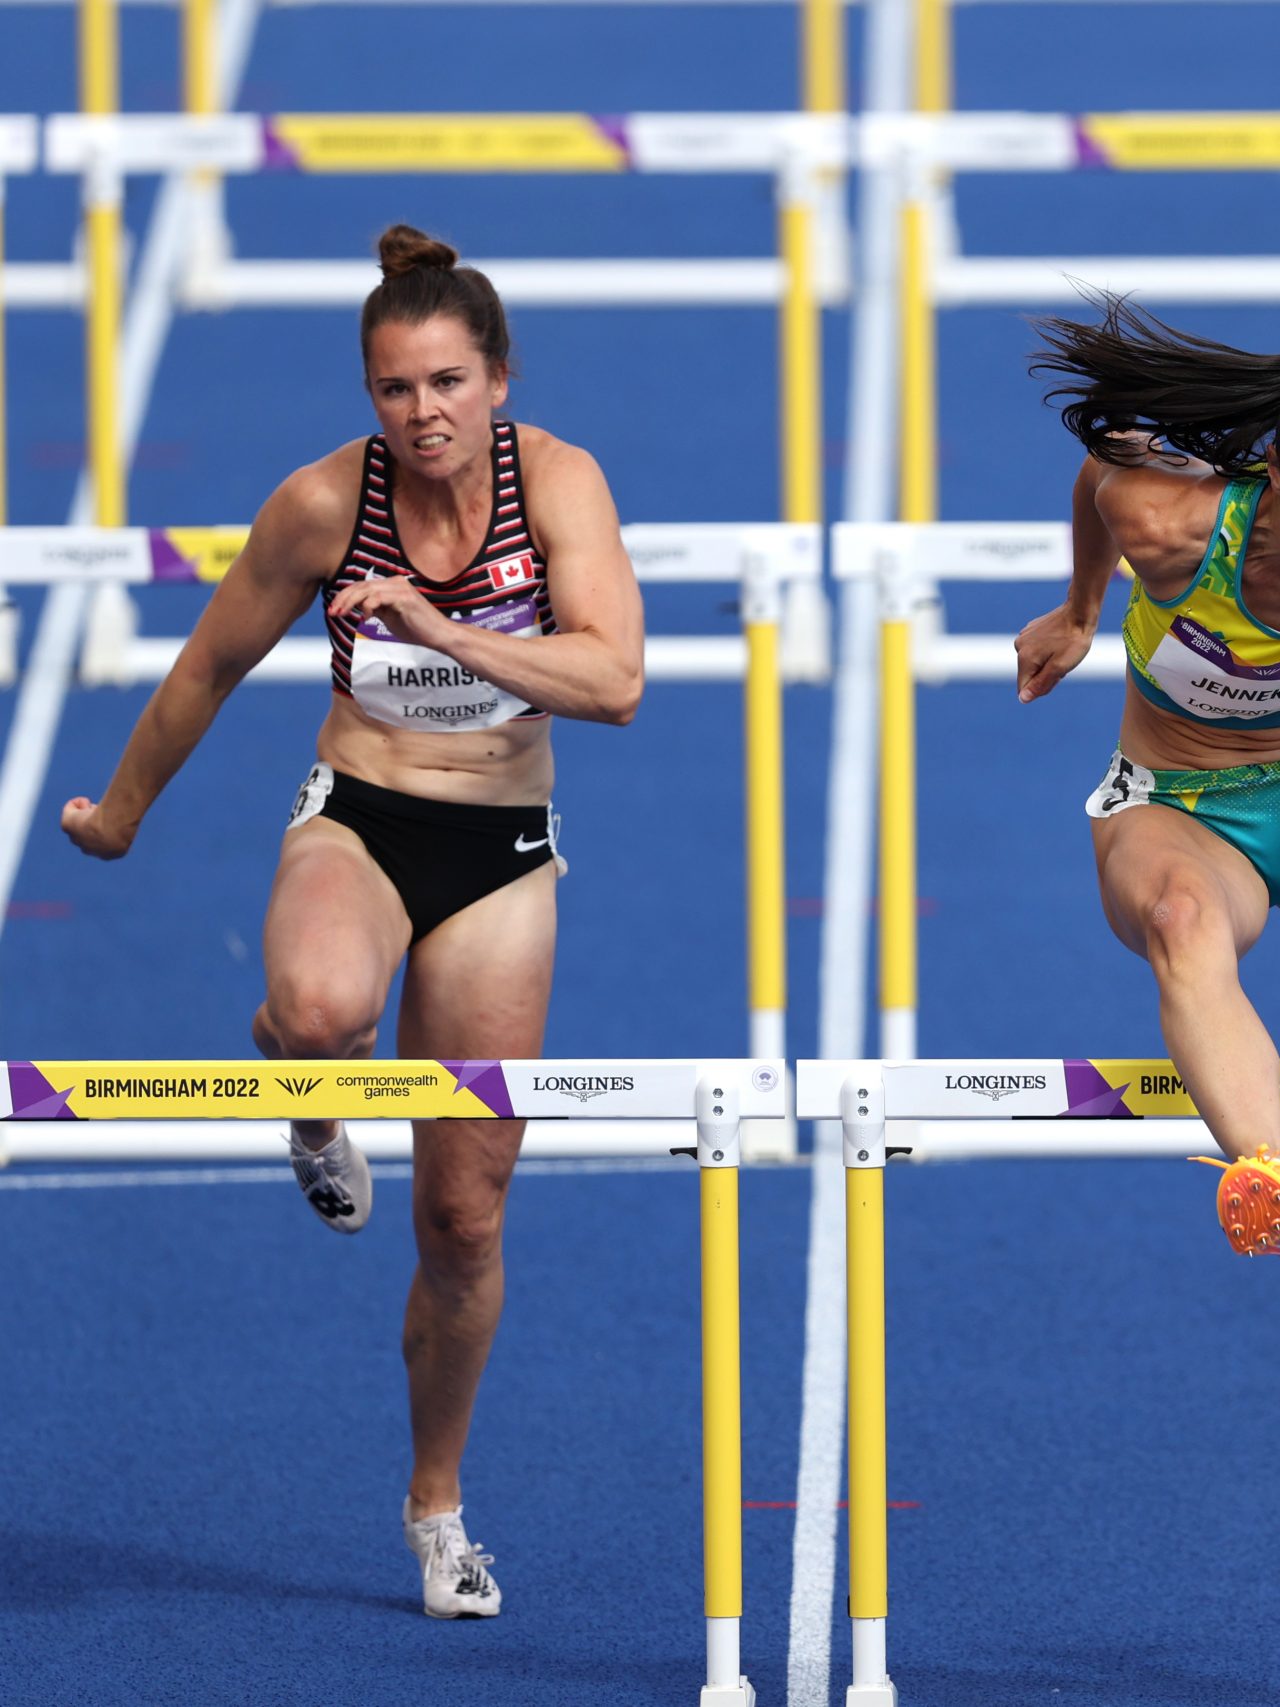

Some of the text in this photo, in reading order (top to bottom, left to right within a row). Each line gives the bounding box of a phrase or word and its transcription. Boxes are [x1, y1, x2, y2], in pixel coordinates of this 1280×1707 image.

[1181, 621, 1227, 657] BIRMINGHAM
[1191, 637, 1211, 654] 2022
[387, 665, 487, 688] HARRIS
[403, 698, 499, 718] LONGINES
[85, 1078, 260, 1098] BIRMINGHAM 2022
[336, 1074, 438, 1087] commonwealth
[533, 1076, 634, 1091] LONGINES
[945, 1075, 1047, 1090] LONGINES
[364, 1087, 410, 1100] games
